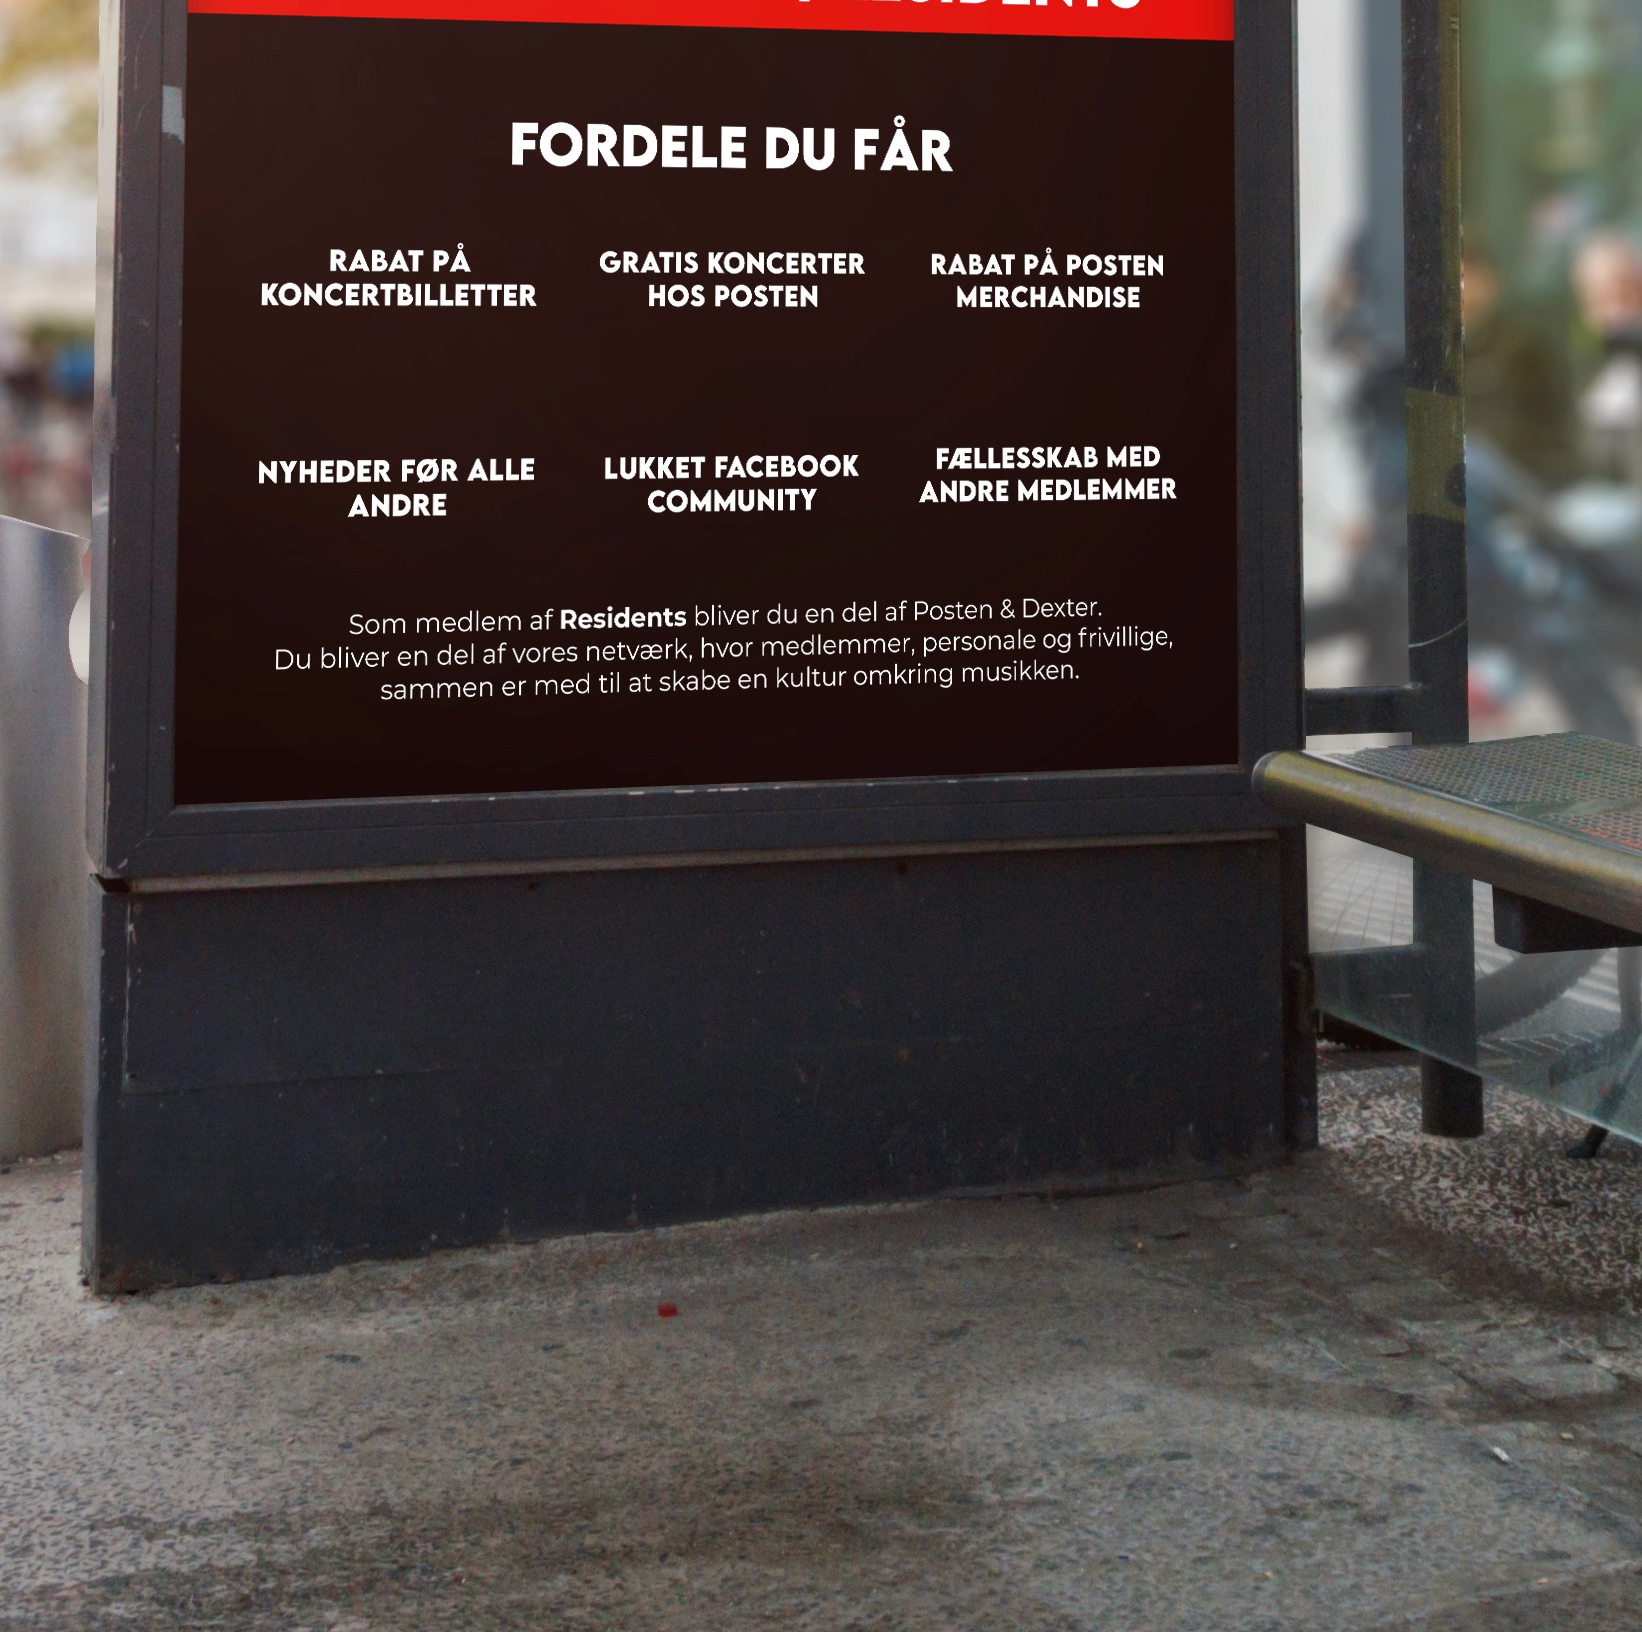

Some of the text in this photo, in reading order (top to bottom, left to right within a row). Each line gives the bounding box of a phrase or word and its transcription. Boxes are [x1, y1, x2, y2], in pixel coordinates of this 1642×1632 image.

[511, 114, 954, 172] FORDELE DU FÅR
[329, 242, 472, 273] RABAT PÅ
[599, 250, 866, 275] GRATIS KONCERTER
[931, 246, 1164, 277] RABAT PÅ POSTEN
[261, 282, 537, 307] KONCERTBILLETTER
[648, 284, 818, 308] HOS POSTEN
[956, 285, 1141, 309] MERCHANDISE
[258, 457, 535, 484] NYHEDER FØR ALLE
[604, 454, 860, 480] LUKKET FACEBOOK
[936, 445, 1161, 470] FÆLLESSKAB MED
[647, 488, 818, 514] COMMUNITY
[918, 477, 1177, 503] ANDRE MEDLEMMER
[347, 493, 447, 518] ANDRE
[349, 598, 1102, 635] Som medlem af Residents bliver du en del af Posten & Dexter.
[275, 625, 1173, 670] Du bliver en del af vores netværk, hvor medlemmer, personale og frivillige,
[380, 659, 1080, 701] sammen er med til at skabe en kultur omkring musikken.
